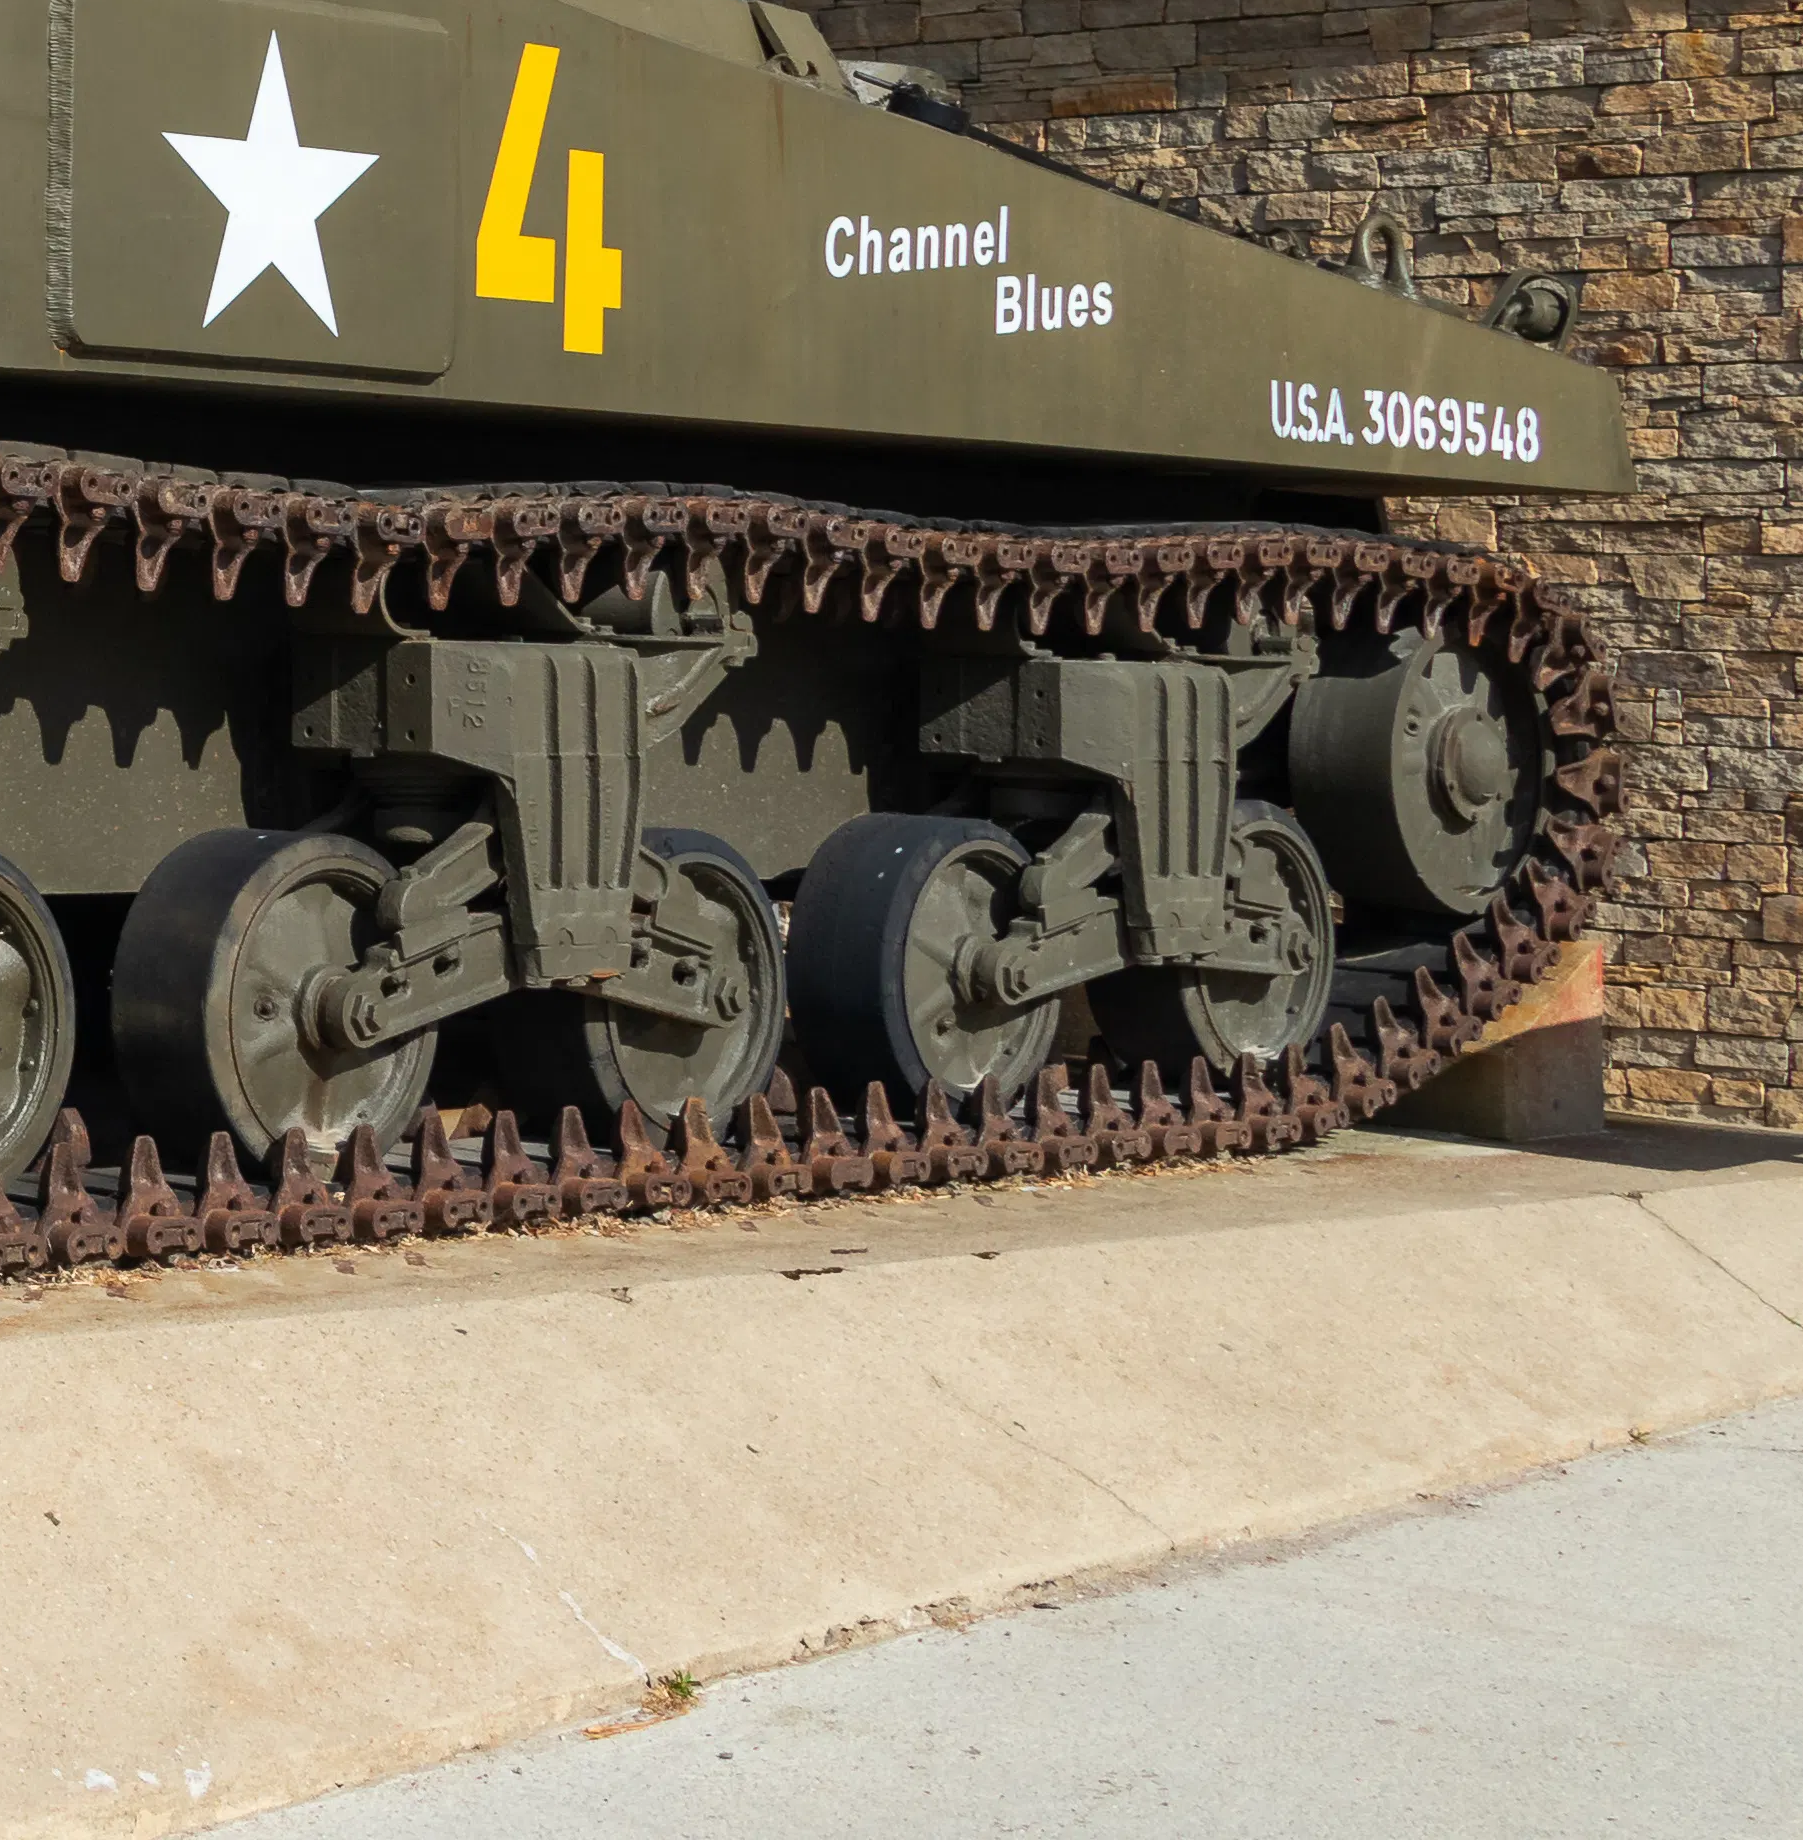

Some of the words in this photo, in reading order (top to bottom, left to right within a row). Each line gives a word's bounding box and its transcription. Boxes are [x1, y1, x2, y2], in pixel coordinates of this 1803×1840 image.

[475, 42, 623, 355] 4
[824, 205, 1009, 279] Channel
[994, 273, 1114, 336] Blues
[1270, 379, 1354, 446] U.S.A.
[1361, 389, 1541, 463] 3069548
